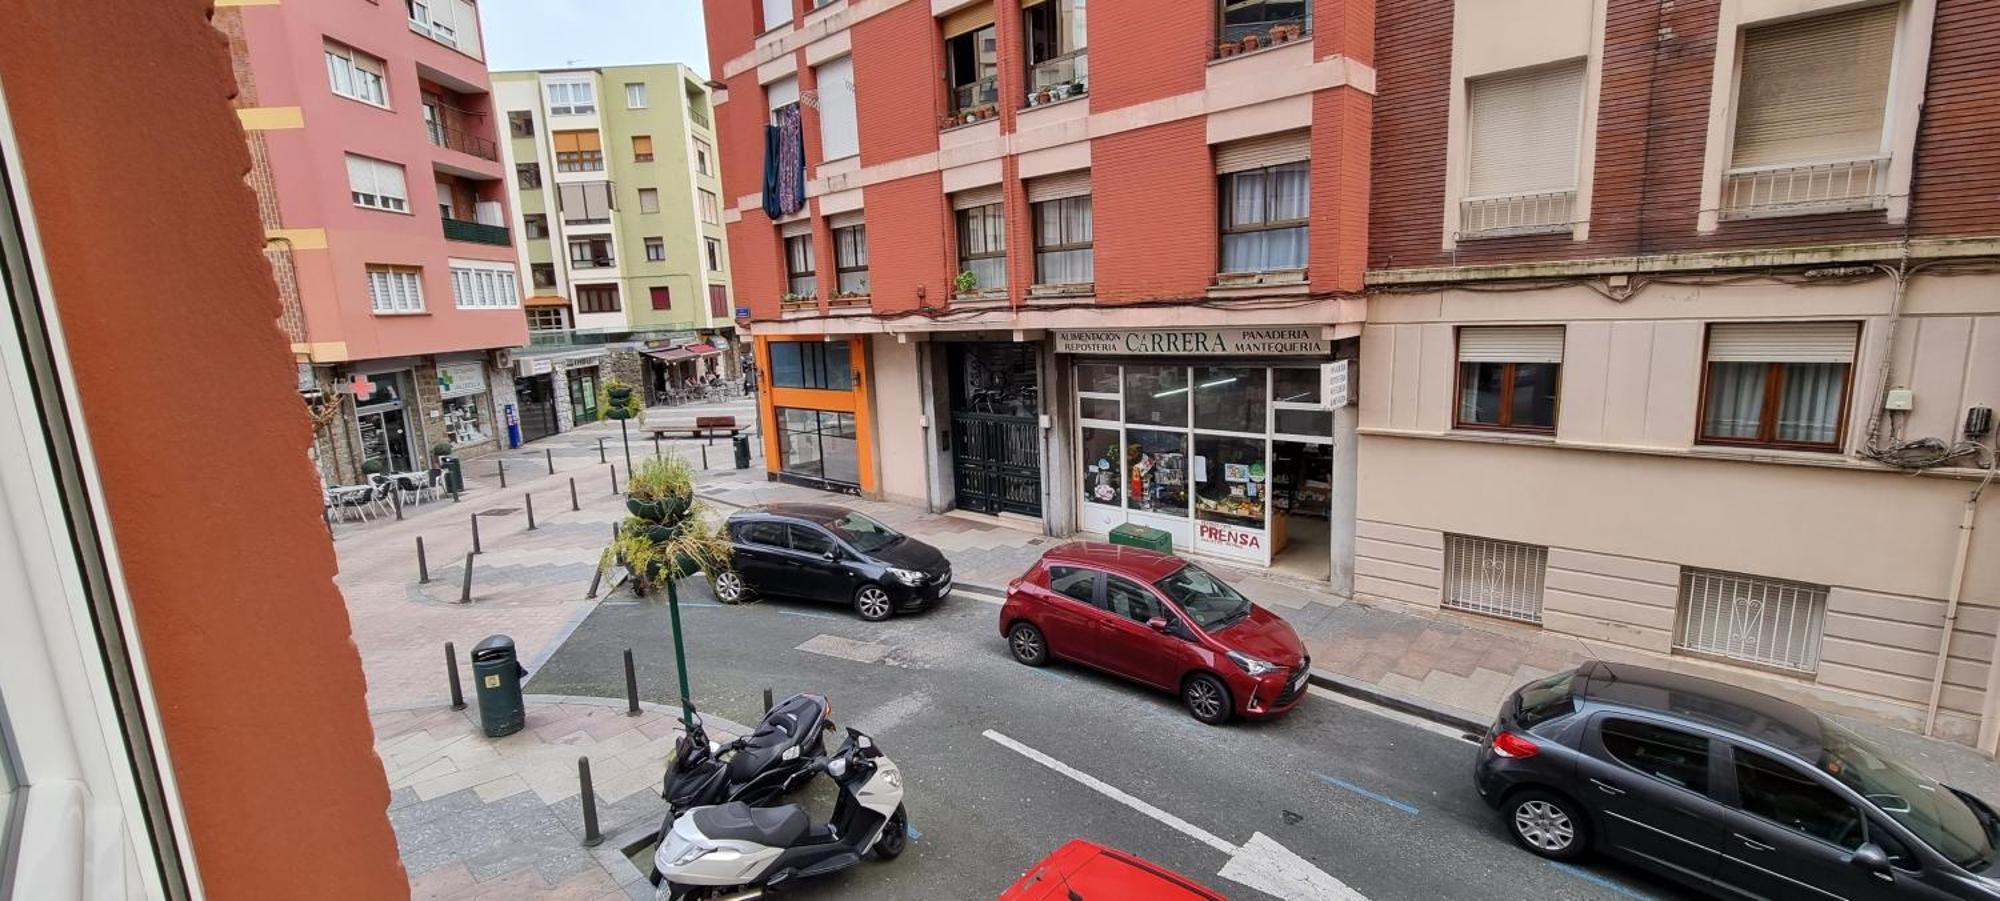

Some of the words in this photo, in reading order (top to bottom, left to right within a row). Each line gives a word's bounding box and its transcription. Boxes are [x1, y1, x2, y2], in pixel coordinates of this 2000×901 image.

[1242, 329, 1310, 340] PANADERIA
[1064, 343, 1117, 352] REPOSTERIA
[1126, 332, 1228, 353] CARRERA
[1234, 342, 1321, 352] MANTEQUERIA
[1200, 525, 1260, 549] PRENSA
